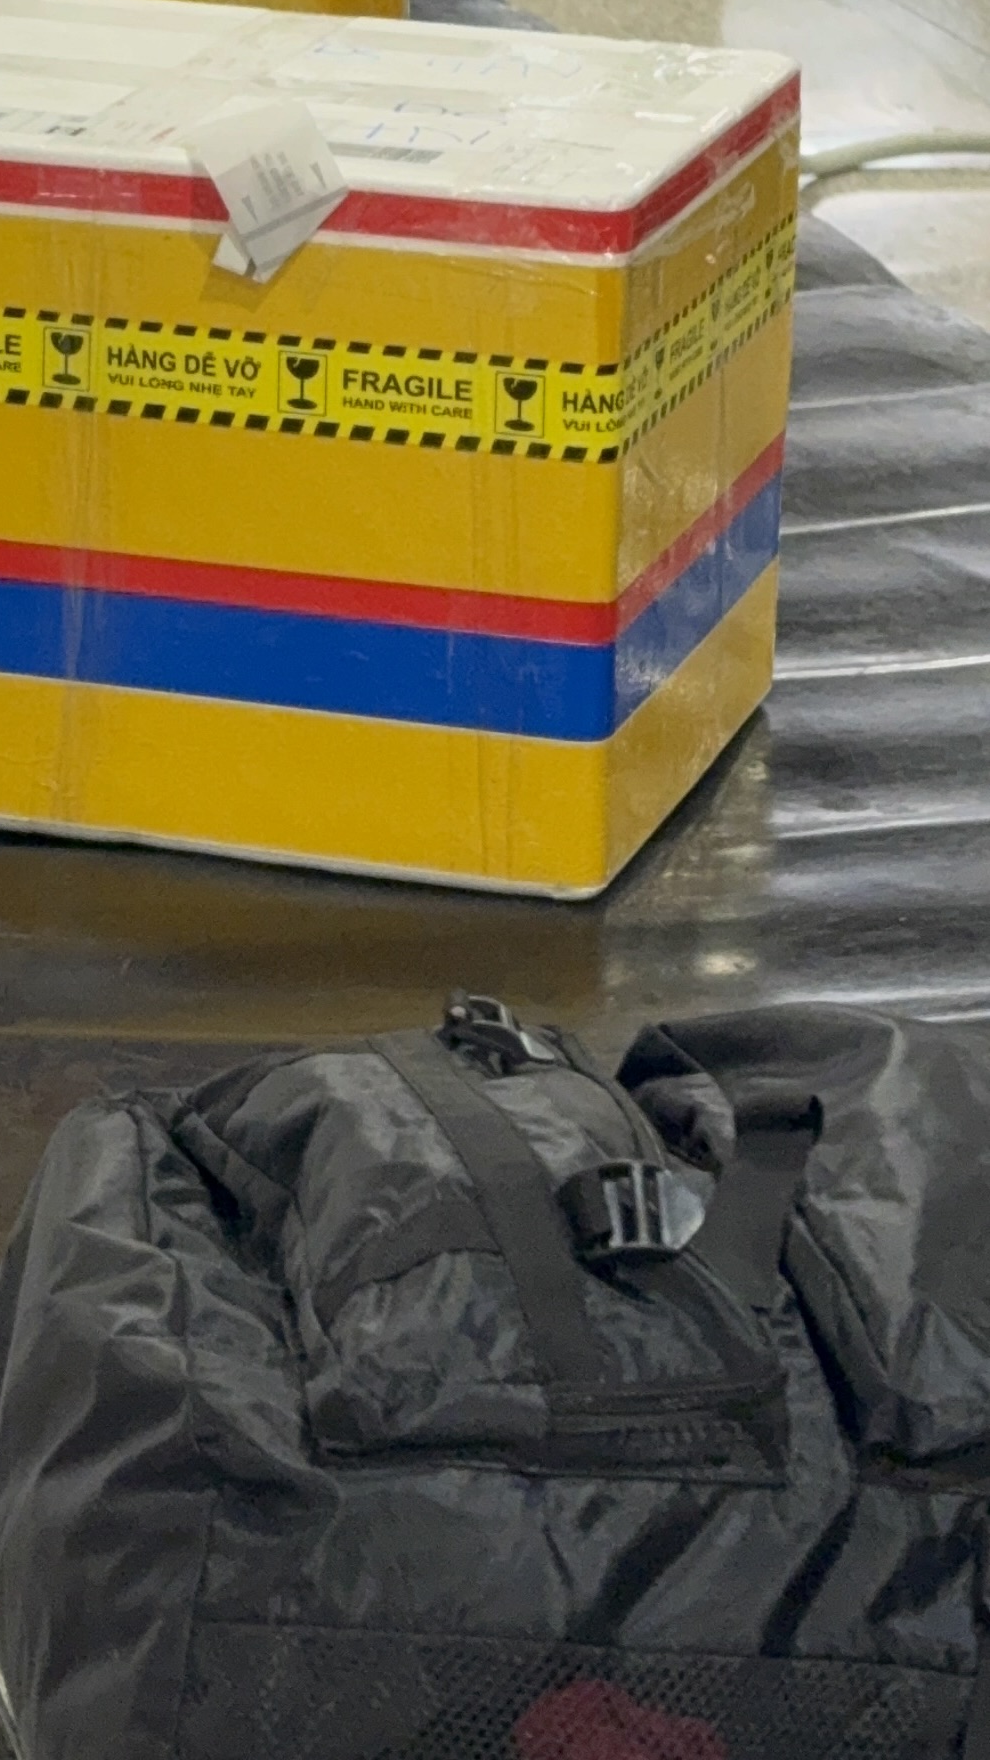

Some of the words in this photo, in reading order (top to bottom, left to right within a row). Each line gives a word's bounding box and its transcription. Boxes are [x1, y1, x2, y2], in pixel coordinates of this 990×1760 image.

[107, 343, 176, 372] HÀNG
[184, 351, 216, 377] DỄ
[224, 356, 261, 381] VỠ
[228, 385, 257, 399] TAY
[343, 368, 473, 402] FRAGILE
[343, 396, 385, 411] HAND
[389, 400, 426, 416] WITH
[431, 405, 473, 420] CARE
[562, 388, 624, 414] HÀNG
[563, 418, 590, 432] VUI
